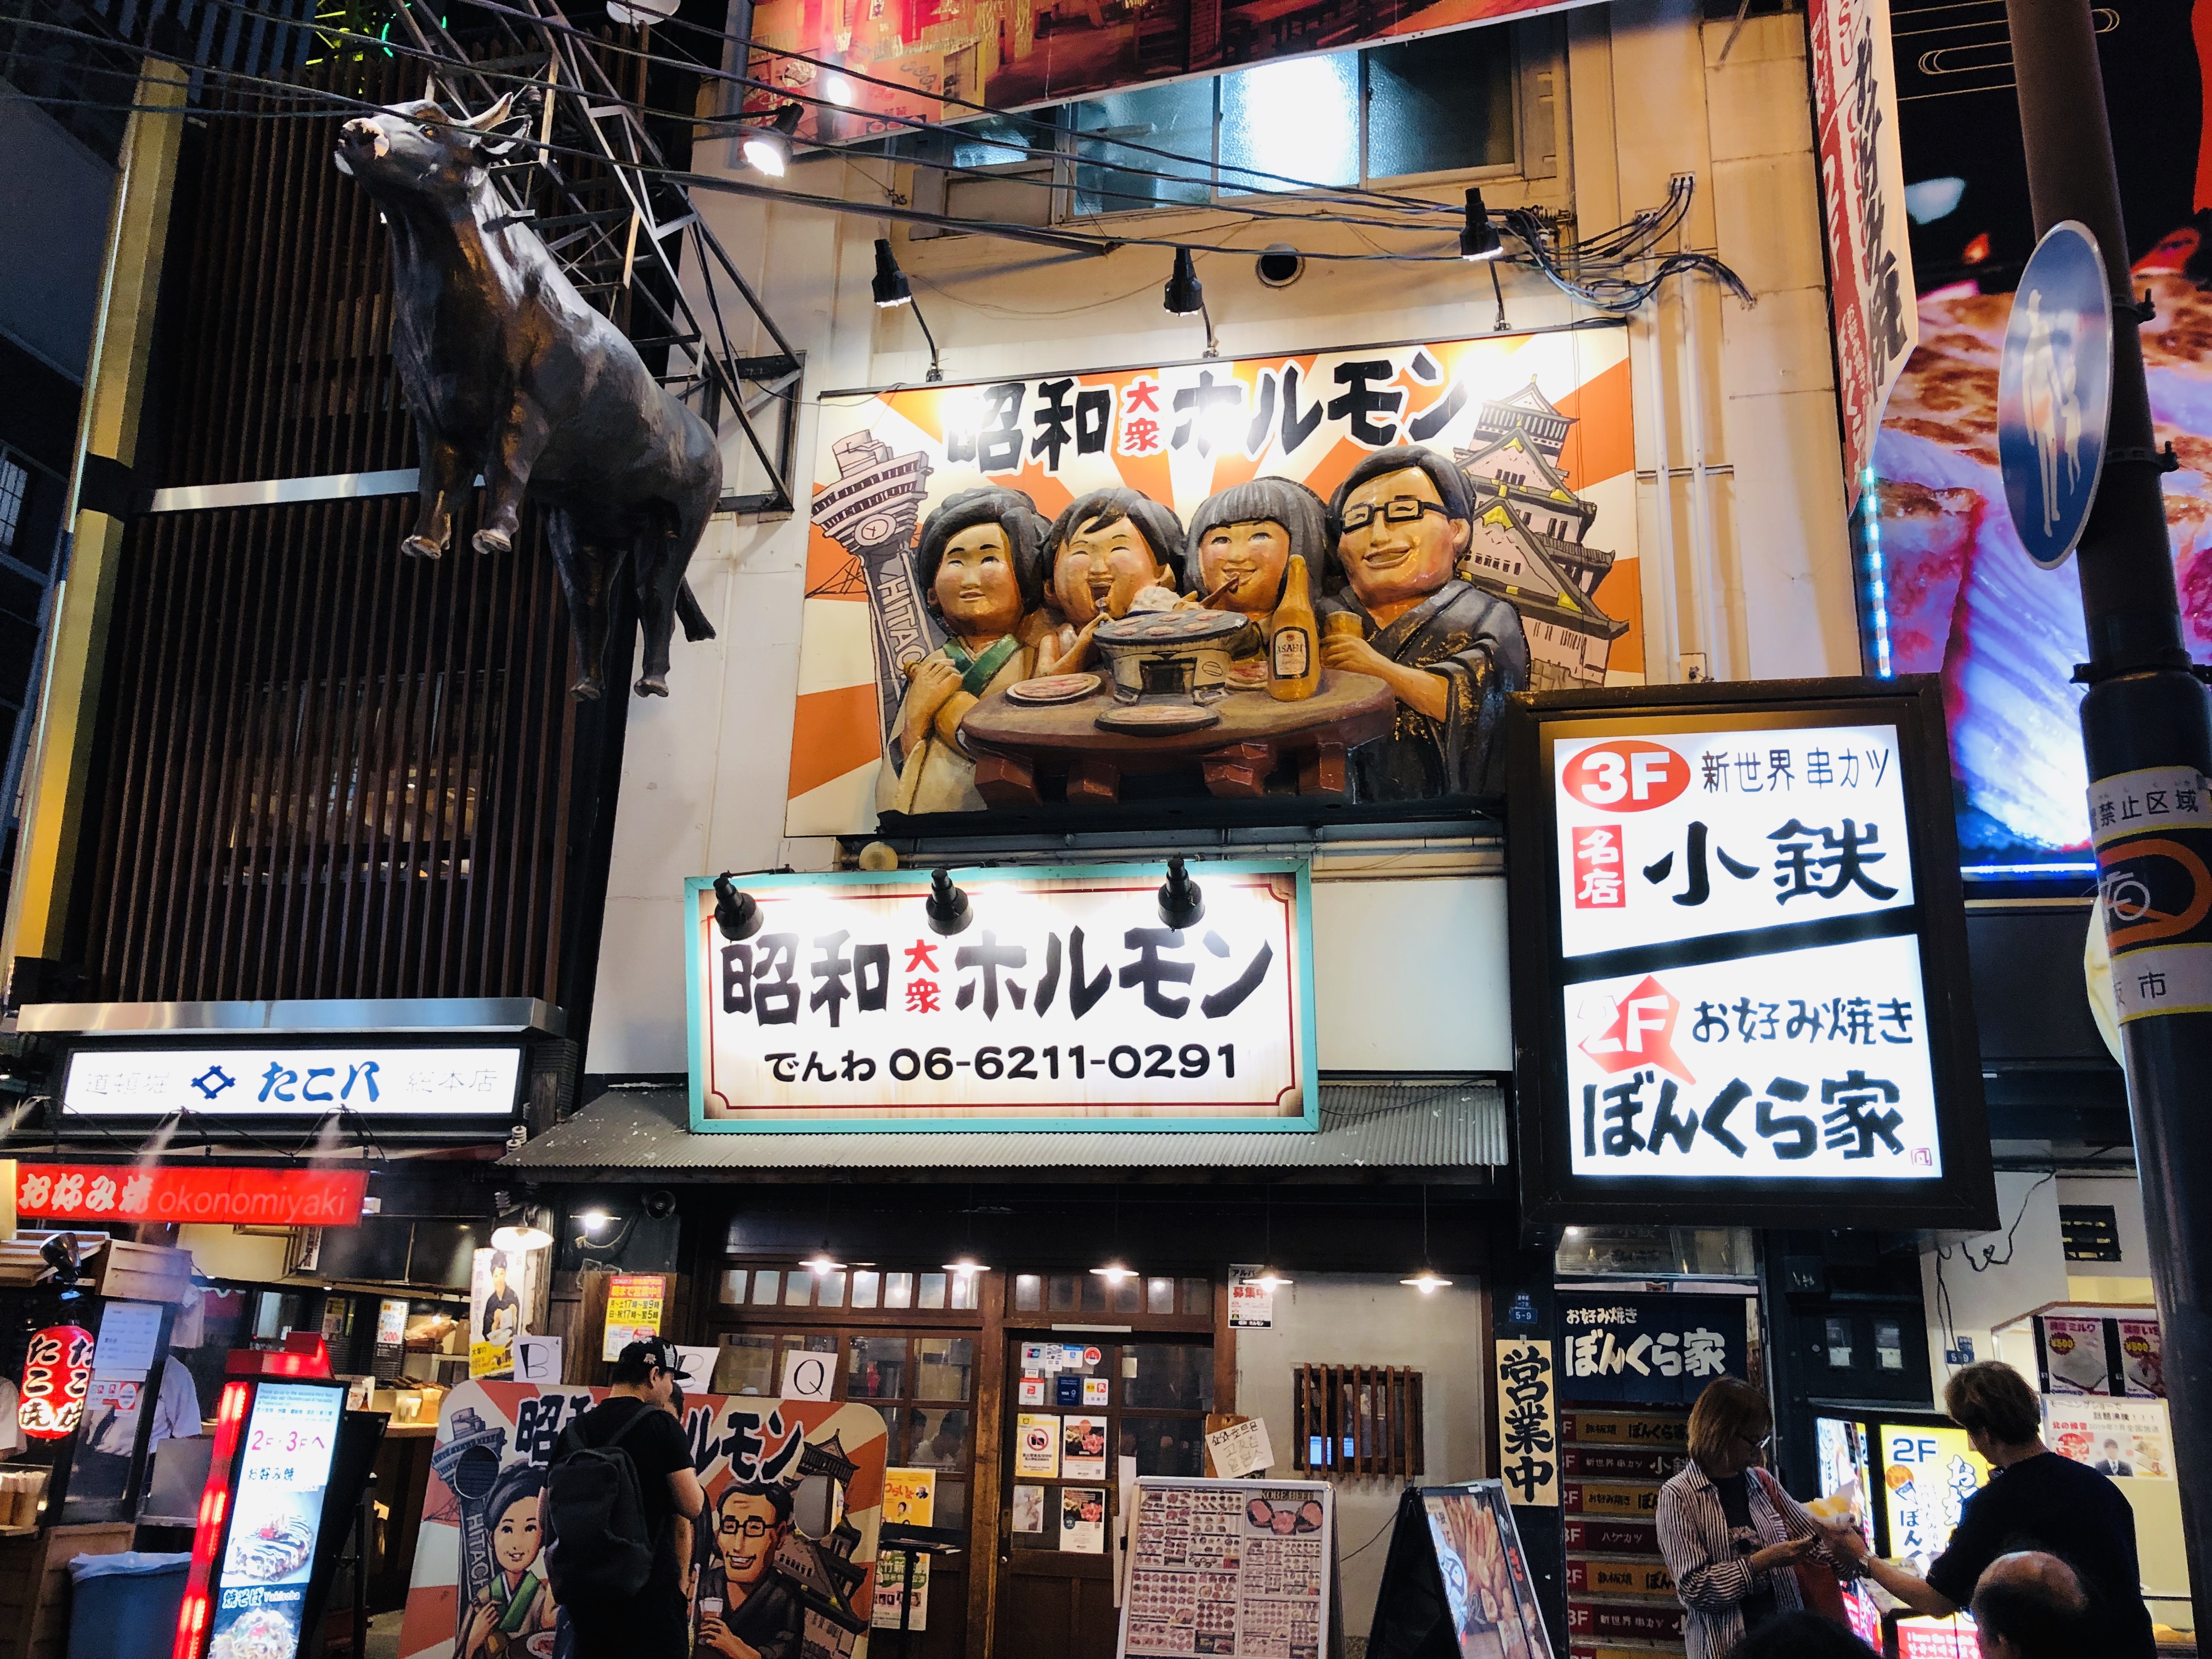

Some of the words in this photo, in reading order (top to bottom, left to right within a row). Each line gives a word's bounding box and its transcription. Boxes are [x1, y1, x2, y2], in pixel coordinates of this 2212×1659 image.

[945, 377, 1111, 472] 昭和
[1125, 381, 1160, 452] 大衆
[1171, 351, 1469, 459] ホルモン
[1276, 644, 1304, 655] ASAHI
[1581, 751, 1671, 804] 3F
[1701, 749, 1796, 793] 新世界
[1807, 747, 1889, 791] 串カツ
[1577, 830, 1622, 904] 名店
[1643, 817, 1899, 906] 小鉄
[721, 928, 890, 1028] 昭和
[904, 938, 942, 1015] 大衆
[955, 924, 1273, 1022] ホルモン
[1577, 995, 1669, 1053] 2F
[1692, 996, 1914, 1045] お好み焼き
[85, 1071, 171, 1096] 道頓堀
[407, 1068, 497, 1093] 総本店
[764, 1049, 876, 1083] でんわ
[888, 1043, 1235, 1082] 06-6211-0291
[1582, 1070, 1905, 1160] ぼんくら家
[157, 1187, 346, 1222] okonomiyaki
[1515, 1311, 1532, 1320] 5-9
[1566, 1307, 1638, 1325] お好み焼き
[520, 1343, 549, 1379] B
[1565, 1327, 1726, 1378] ぼんくら家
[19, 1334, 61, 1429] たこ焼
[793, 1359, 824, 1395] Q
[1500, 1345, 1554, 1503] 営業中
[1585, 1457, 1614, 1468] 新世界
[1892, 1437, 1937, 1463] 2F
[1261, 1489, 1286, 1500] KOBE
[1565, 1528, 1581, 1543] 3F
[1568, 1610, 1589, 1626] 3F
